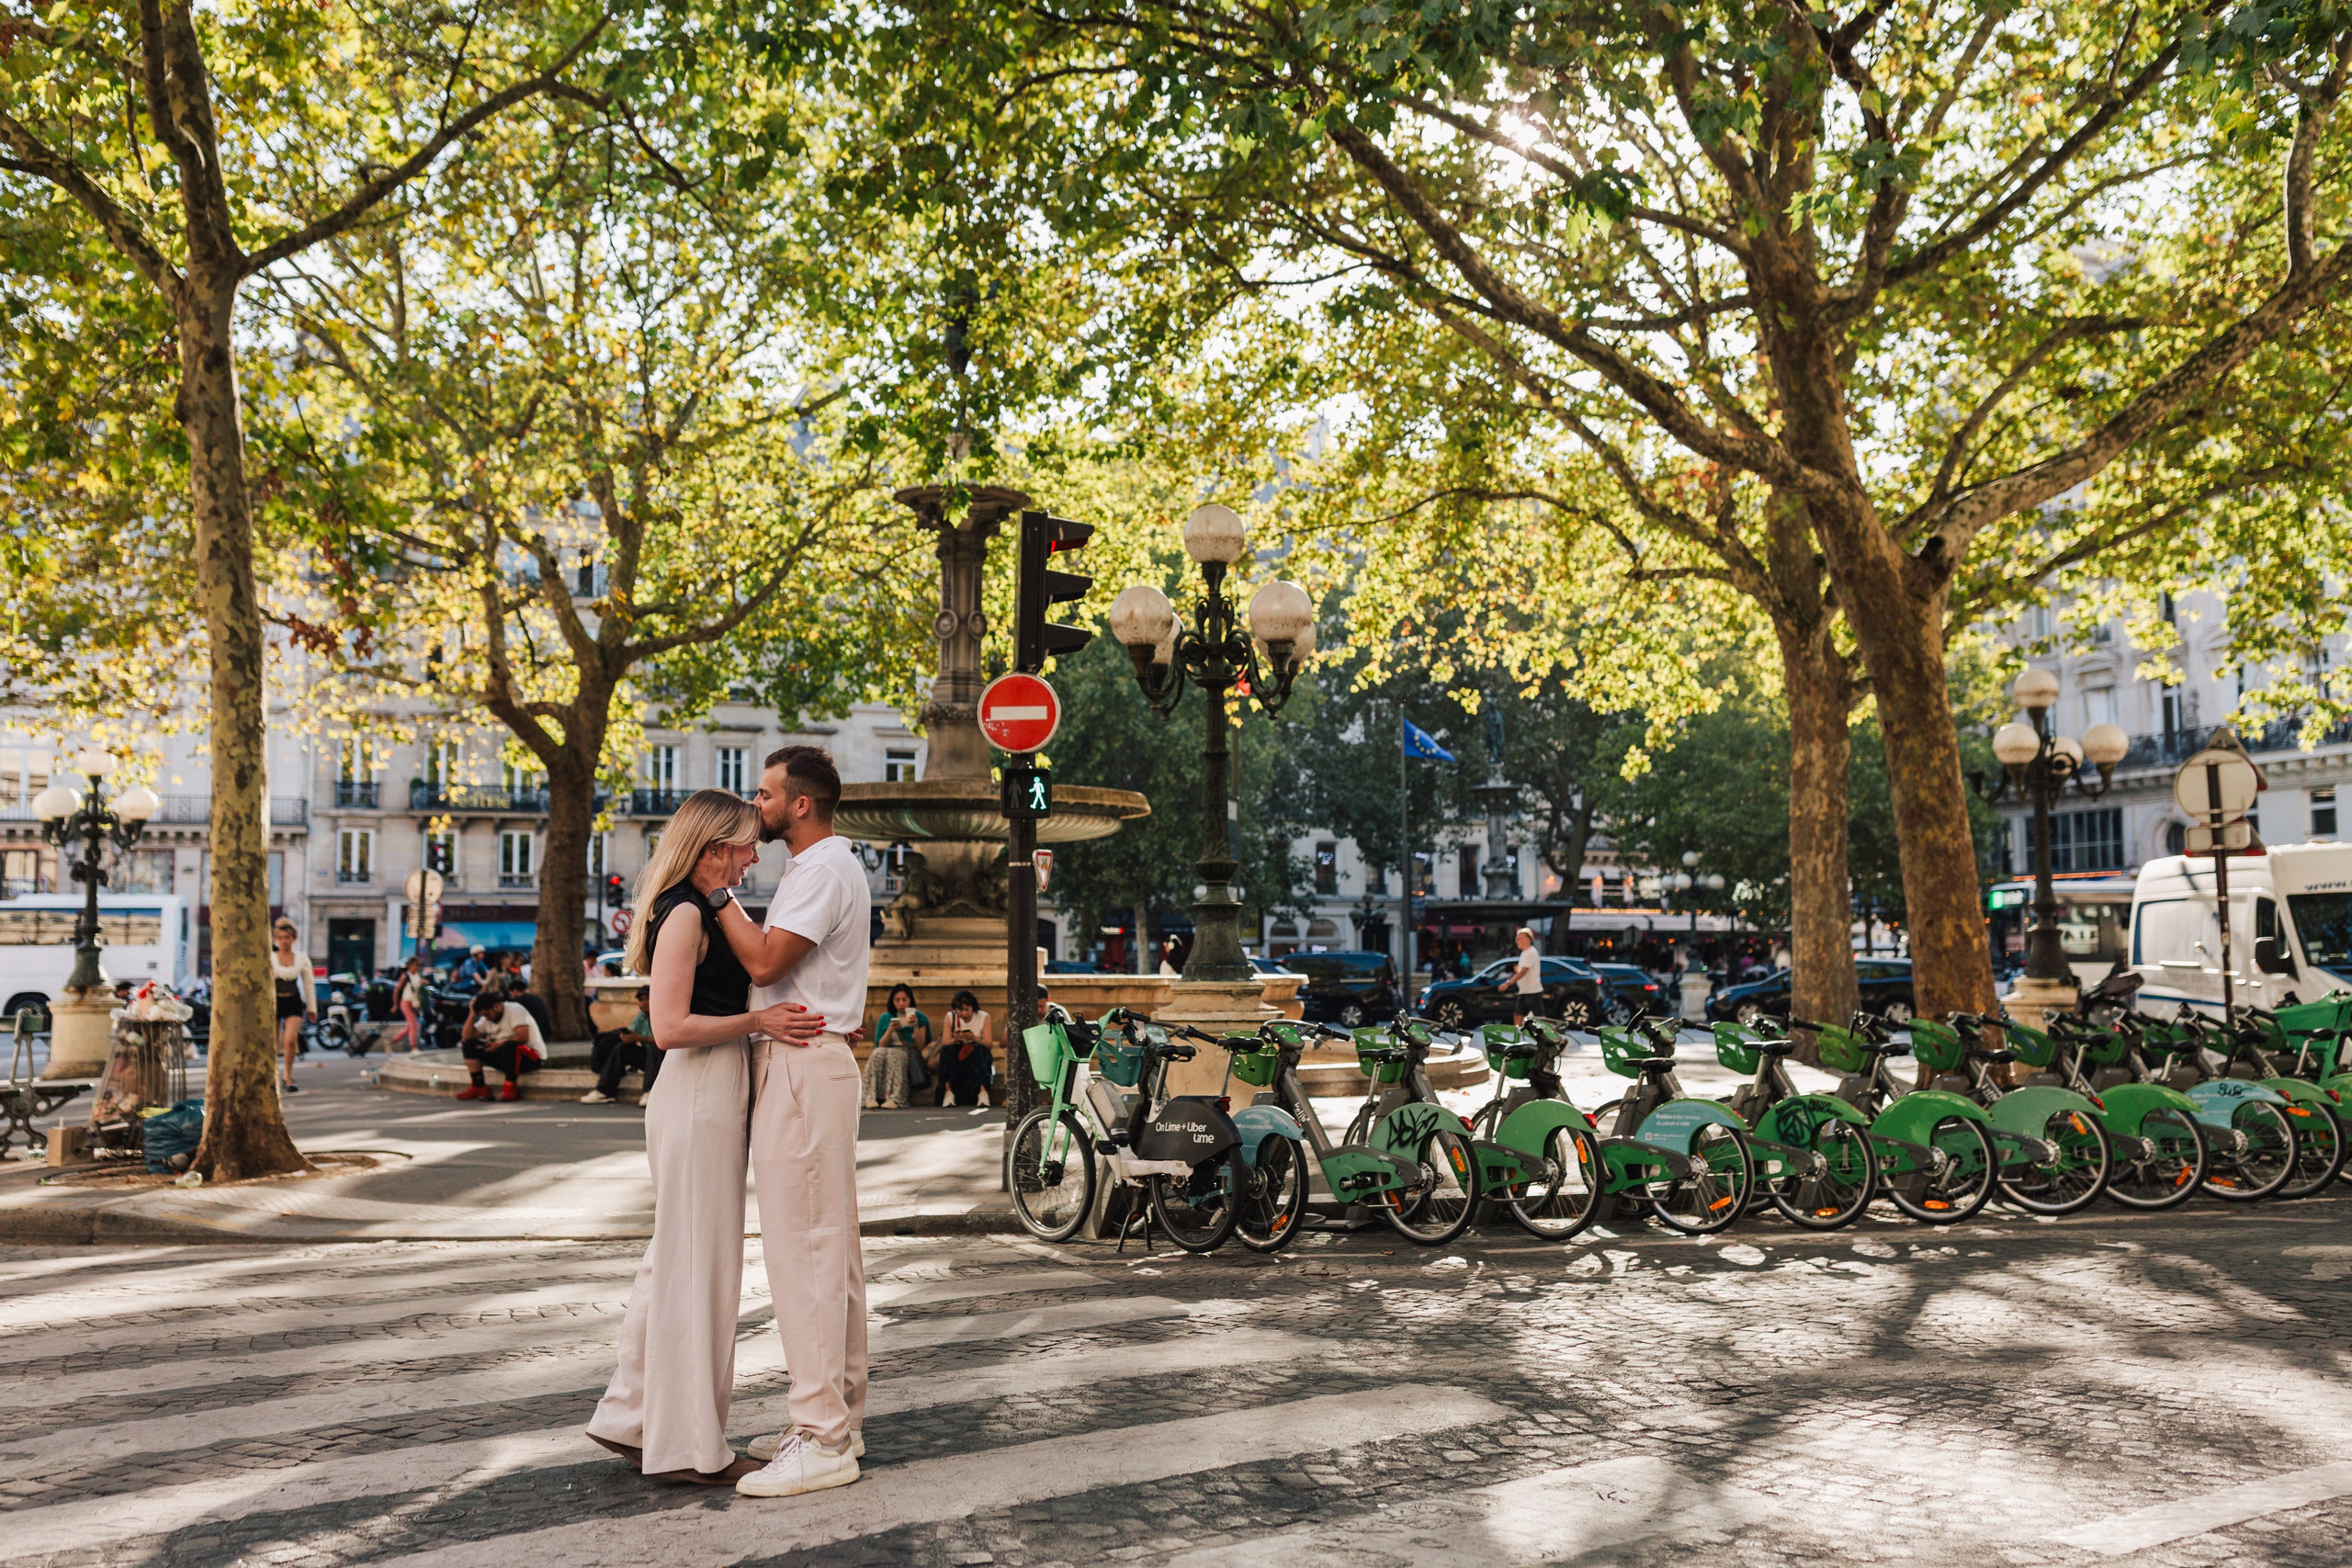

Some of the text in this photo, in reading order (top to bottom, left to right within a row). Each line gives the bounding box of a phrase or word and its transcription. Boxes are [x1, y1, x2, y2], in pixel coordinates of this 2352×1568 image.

[1156, 1122, 1164, 1132] On
[1165, 1122, 1181, 1132] Lime
[1187, 1122, 1206, 1132] Uber
[1193, 1134, 1215, 1144] Lime
